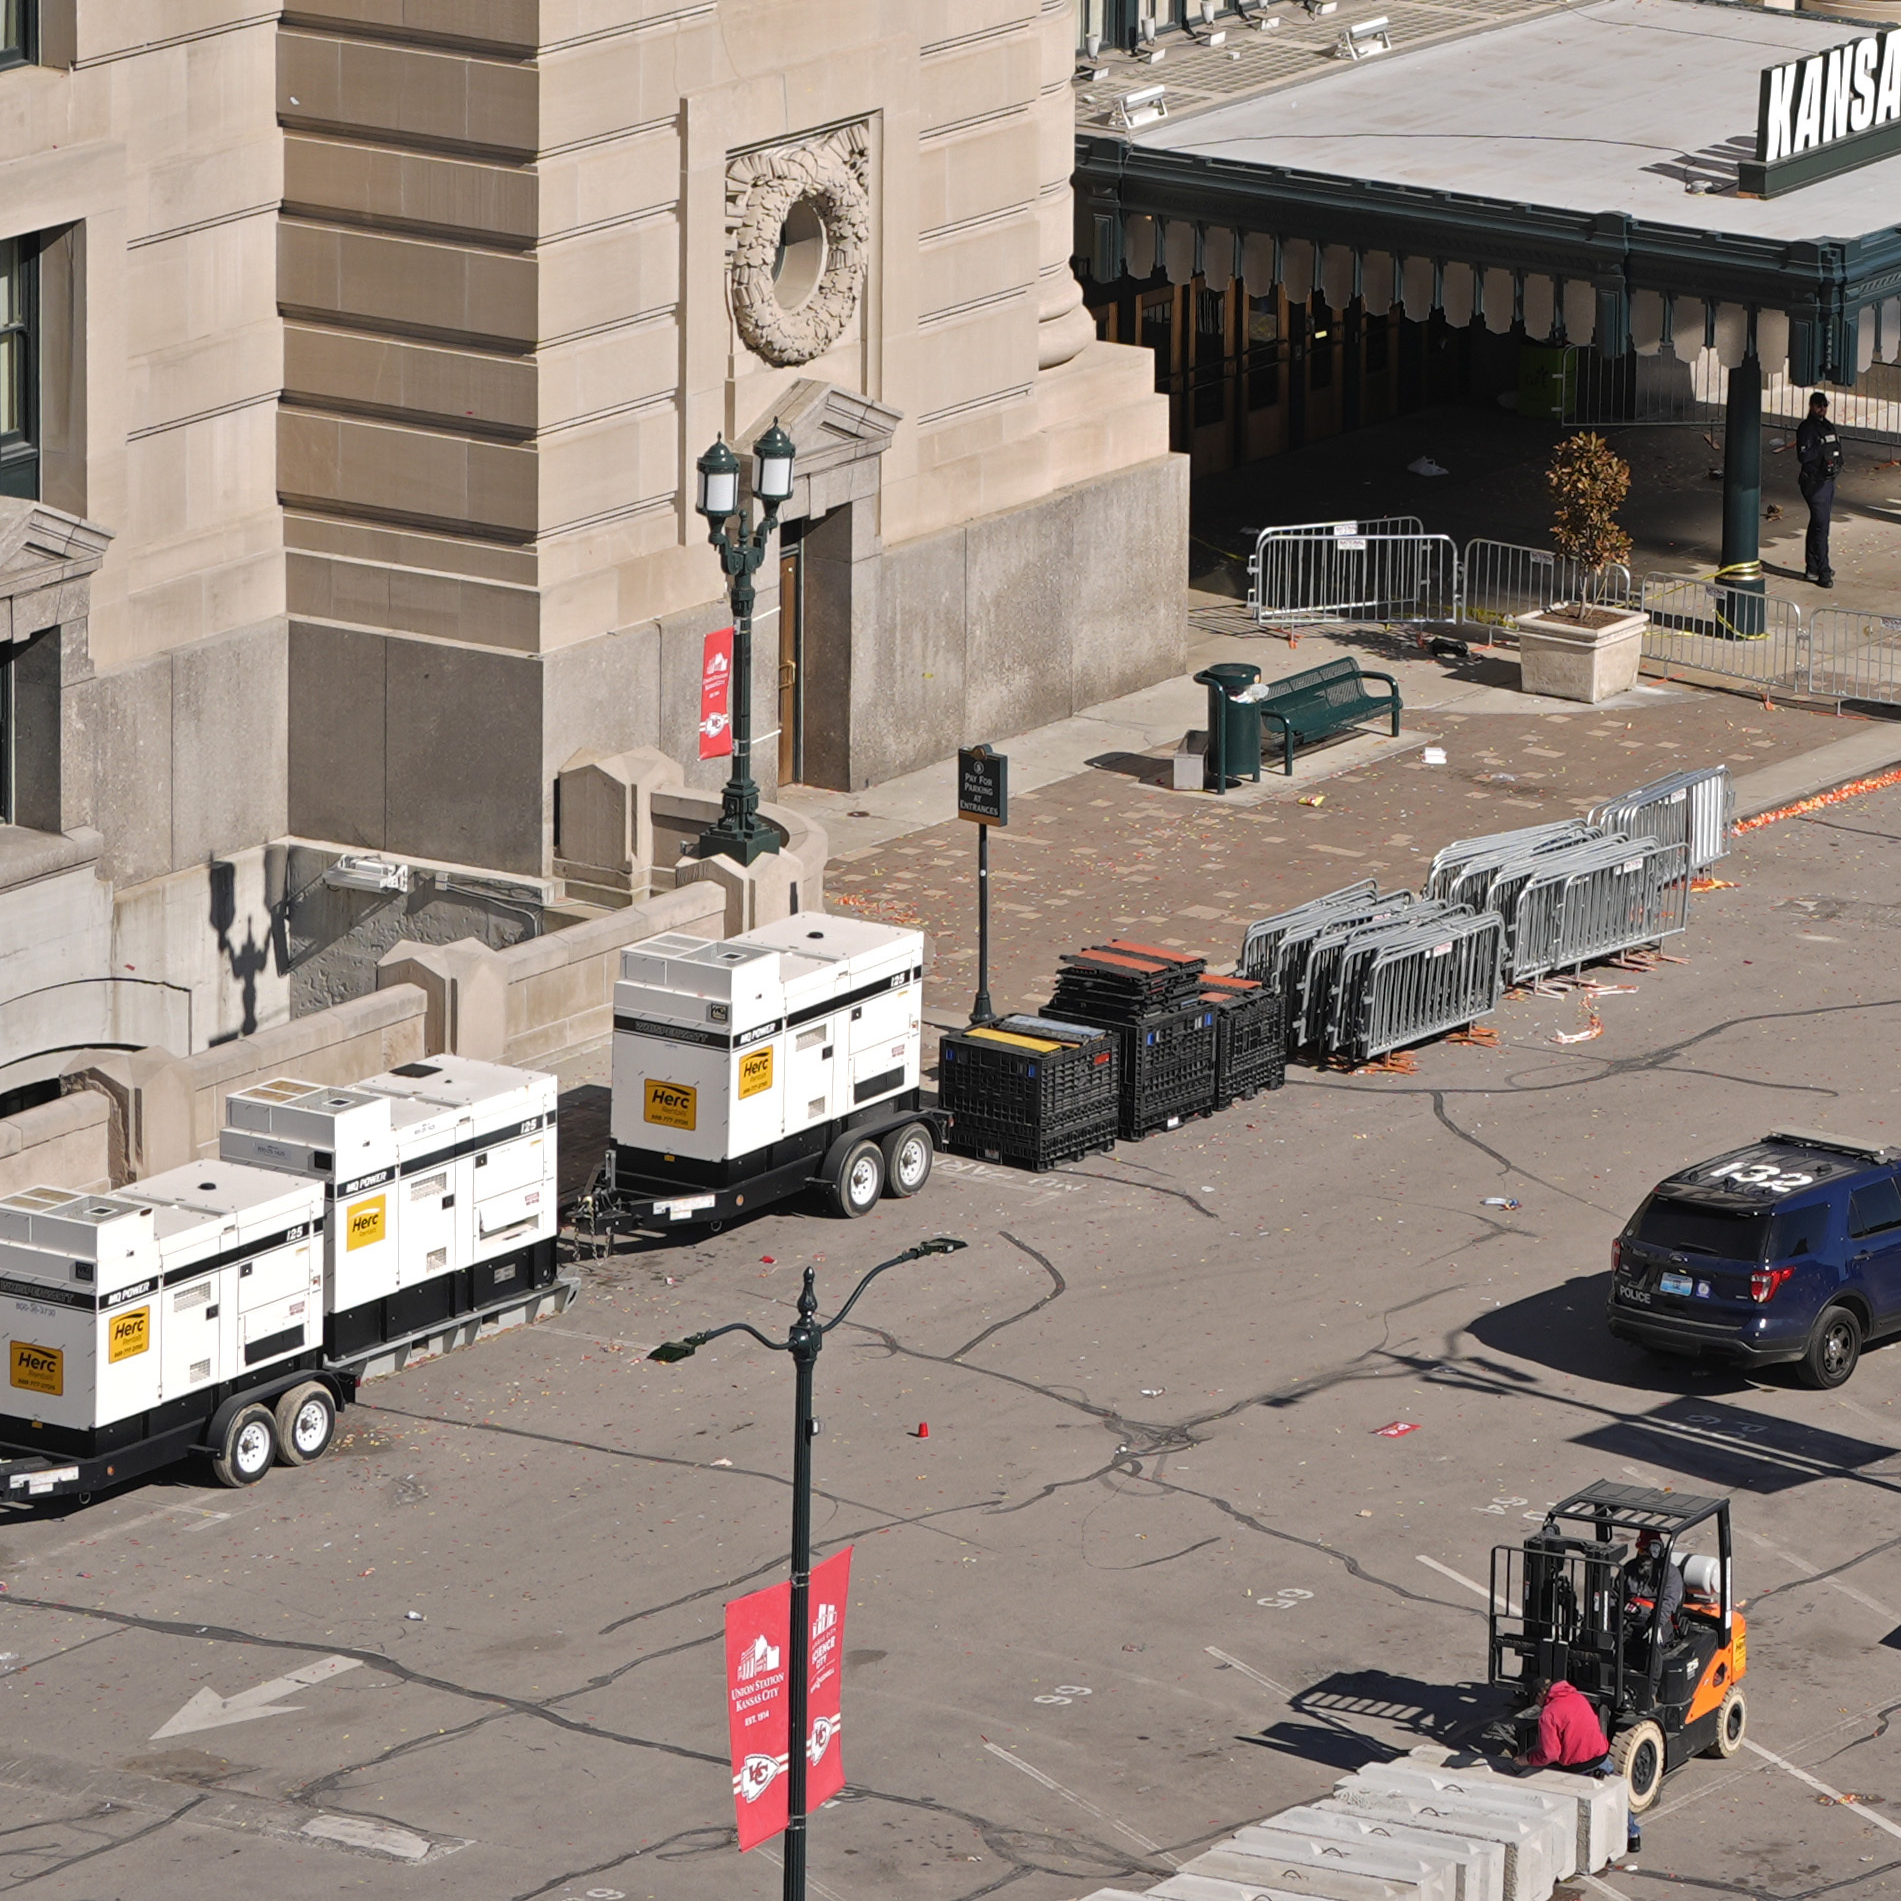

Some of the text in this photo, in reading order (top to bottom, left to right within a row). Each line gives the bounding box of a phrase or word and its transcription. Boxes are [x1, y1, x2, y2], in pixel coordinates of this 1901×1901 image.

[964, 782, 994, 797] PARKING
[965, 772, 993, 786] PAY FOR
[960, 800, 999, 816] ENTRANCES
[973, 794, 982, 803] AT
[890, 972, 906, 988] 125
[751, 1022, 776, 1041] POWER
[743, 1056, 768, 1078] Herc
[651, 1089, 691, 1110] Herc
[520, 1118, 538, 1134] 125
[359, 1171, 387, 1190] POWER
[1709, 1161, 1814, 1192] 132
[285, 1225, 304, 1242] 125
[351, 1212, 379, 1234] Herc
[108, 1281, 150, 1305] MQ POWER
[1619, 1284, 1652, 1305] POLICE
[114, 1318, 144, 1341] Herc
[17, 1352, 57, 1373] Herc
[811, 1635, 836, 1665] SCIENCE
[816, 1654, 828, 1670] CITY
[731, 1672, 785, 1701] UNION STATION
[736, 1686, 780, 1713] KANSAS CITY
[744, 1715, 757, 1727] EST.
[748, 1762, 769, 1786] KC
